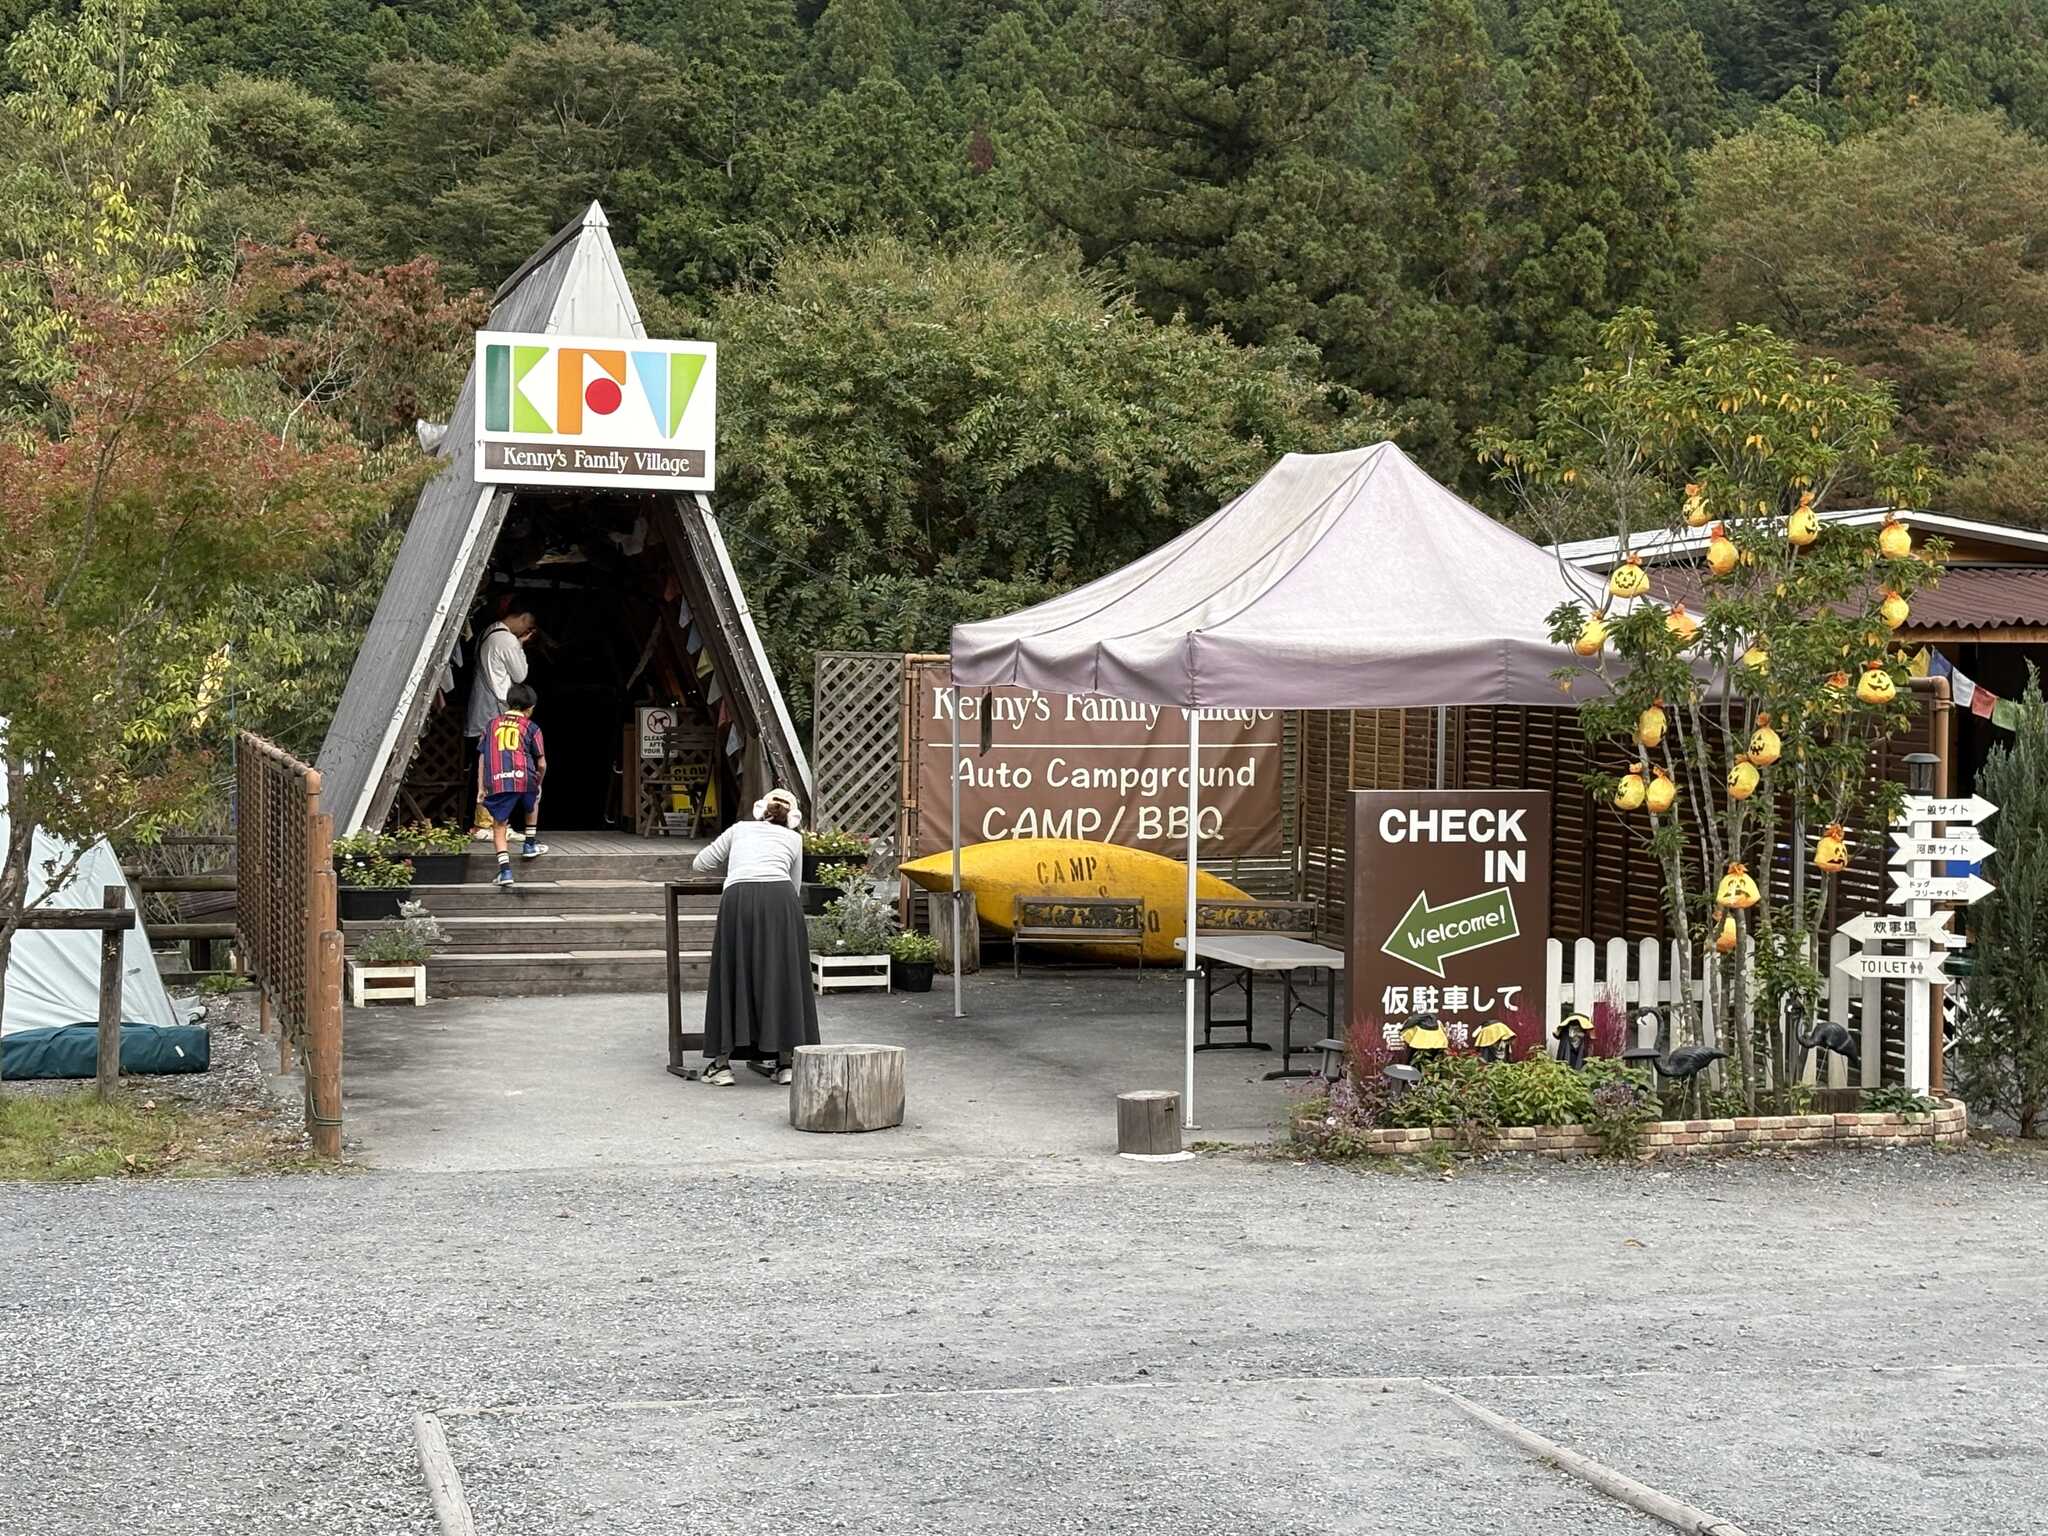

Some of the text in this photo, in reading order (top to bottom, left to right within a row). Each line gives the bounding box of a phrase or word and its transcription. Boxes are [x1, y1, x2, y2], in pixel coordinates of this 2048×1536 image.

[504, 447, 690, 476] Kenny's Family Village
[495, 726, 520, 752] 10
[951, 757, 1256, 795] Auto Campground
[1916, 804, 1969, 815] 一般サイト
[1379, 809, 1528, 843] CHECK
[1916, 843, 1969, 855] 河原サイト
[1037, 856, 1097, 885] CAMP
[1484, 850, 1526, 883] IN
[1407, 904, 1506, 949] Welcome!
[1873, 921, 1917, 934] 炊事場
[1860, 960, 1908, 974] TOILET
[1381, 984, 1523, 1015] 仮駐車して
[1382, 1019, 1482, 1050] 管棟
